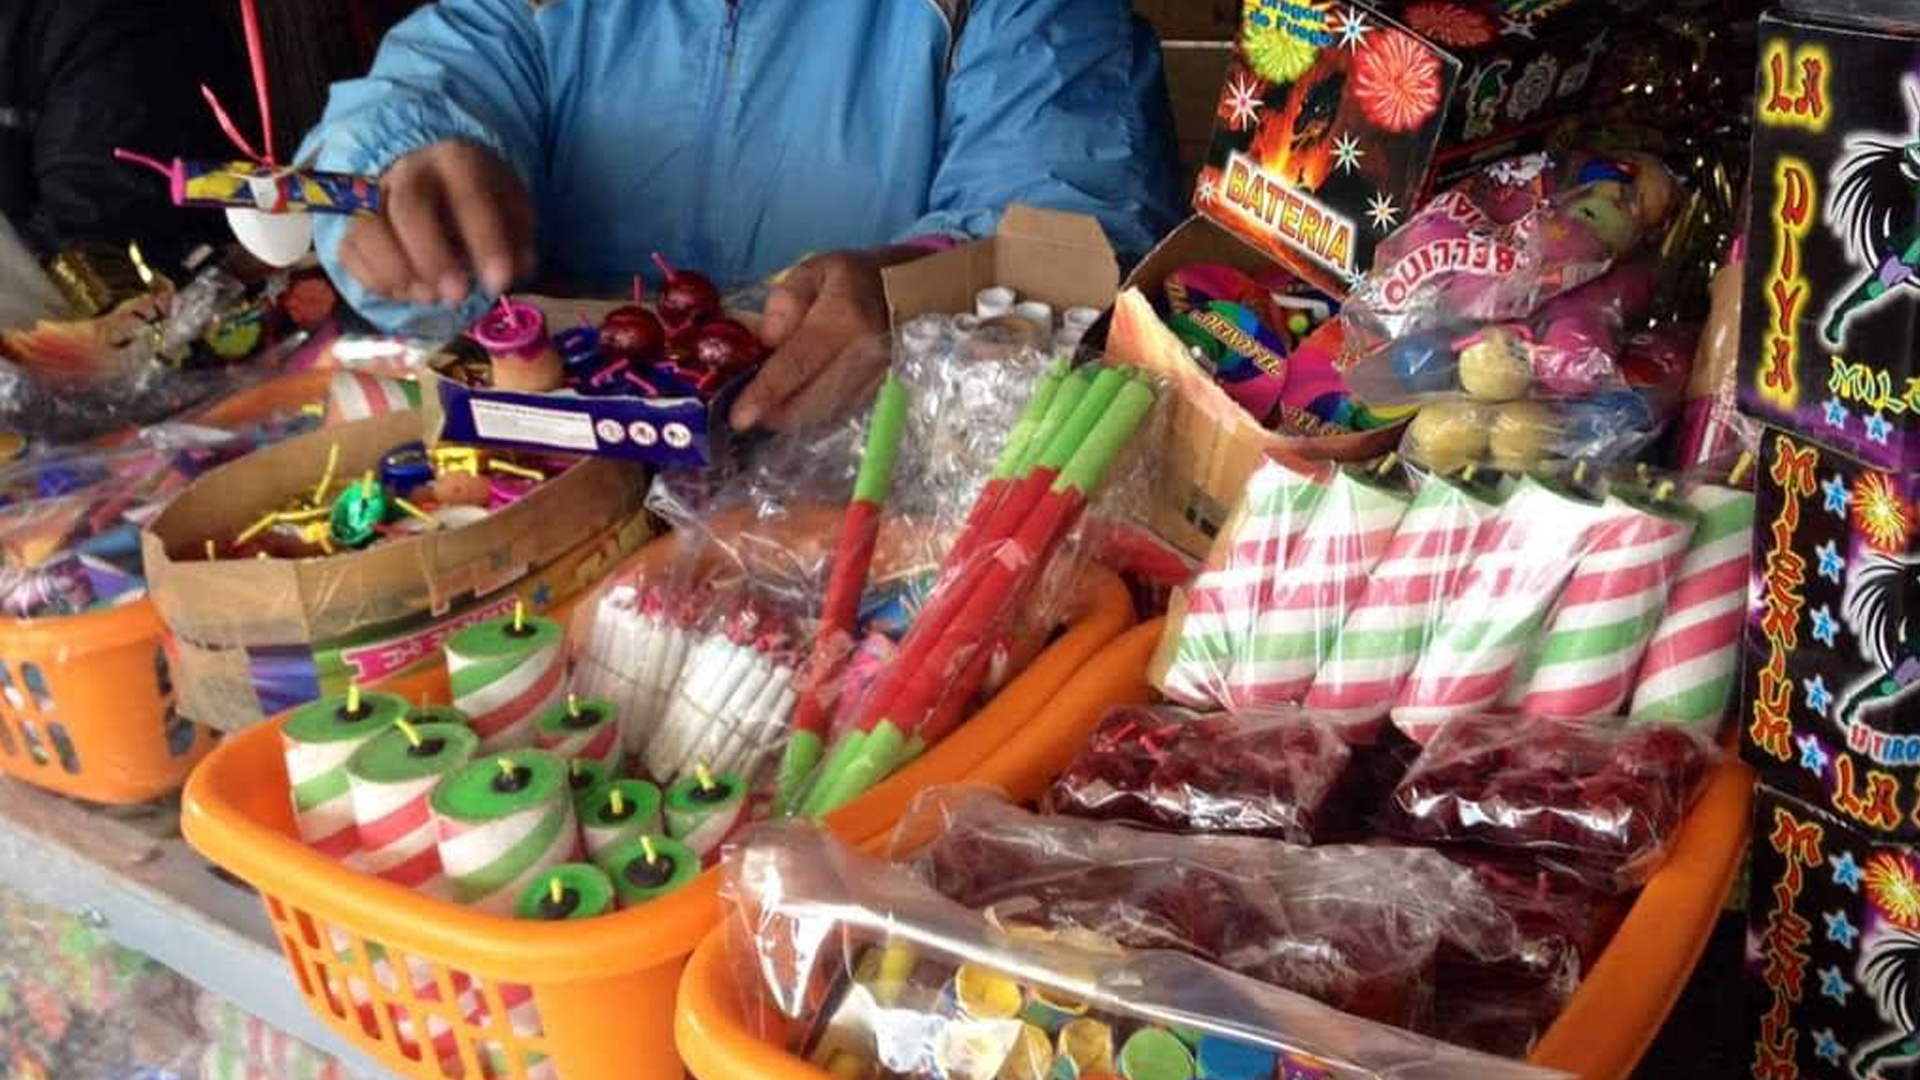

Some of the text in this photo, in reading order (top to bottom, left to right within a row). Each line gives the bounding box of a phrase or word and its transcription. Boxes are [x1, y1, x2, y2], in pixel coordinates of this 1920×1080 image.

[1763, 49, 1827, 120] LA
[1224, 161, 1354, 272] BATERIA
[1832, 753, 1900, 831] LA
